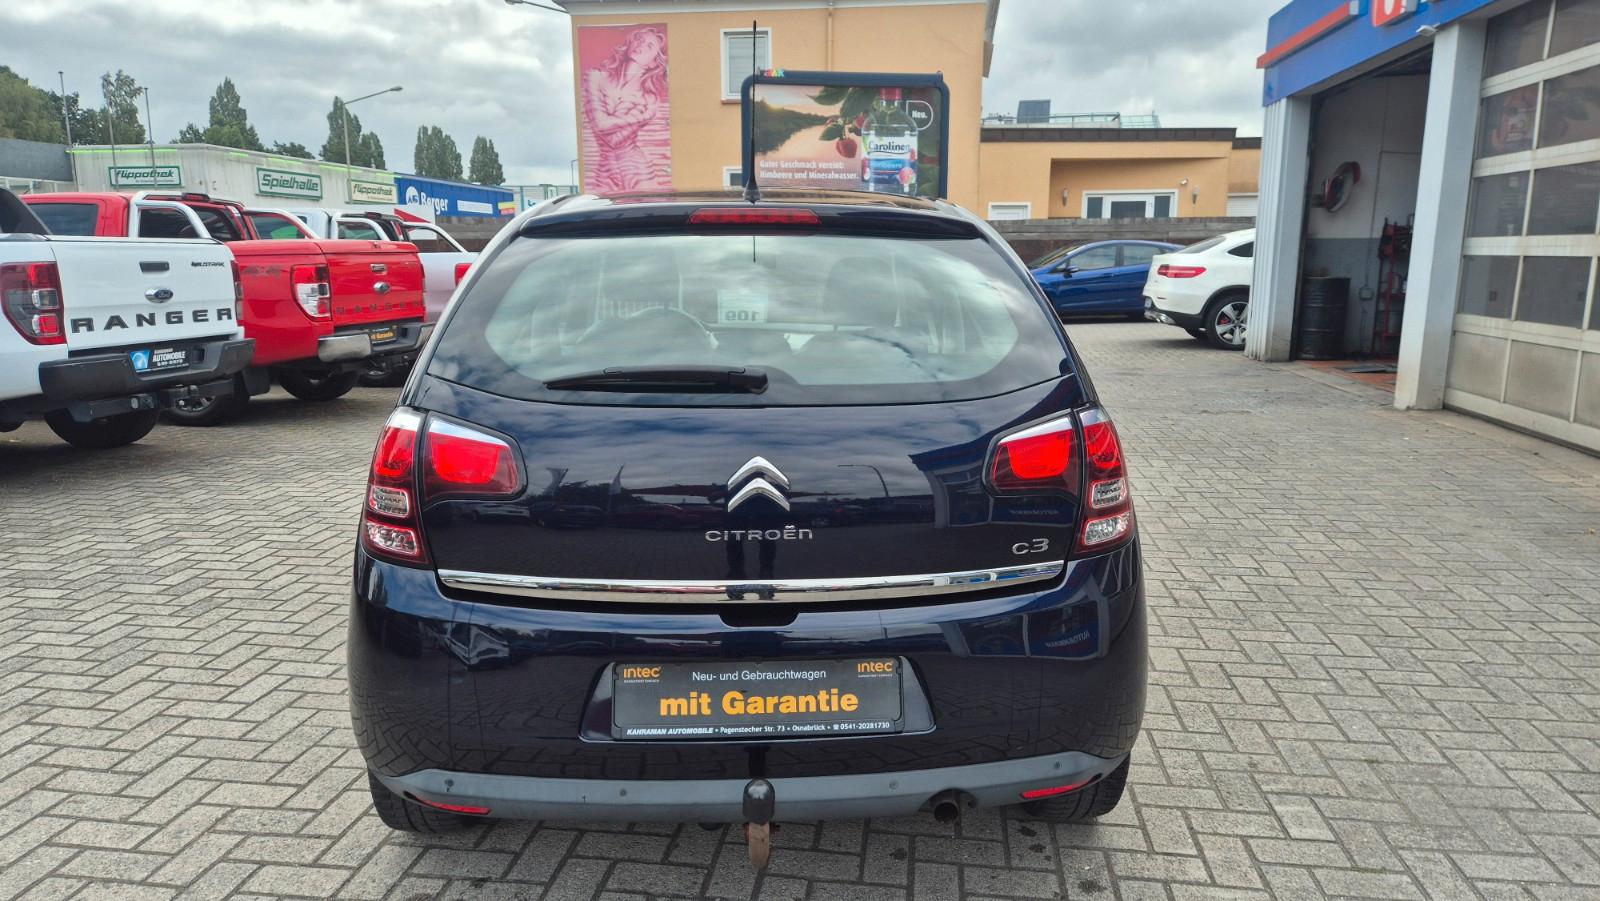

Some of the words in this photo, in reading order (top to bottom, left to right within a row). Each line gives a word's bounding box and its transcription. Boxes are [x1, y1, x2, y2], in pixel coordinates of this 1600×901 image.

[911, 110, 928, 119] Neu.
[780, 160, 817, 169] Geschmack
[793, 171, 808, 179] und
[809, 171, 860, 180] Mineralwasser.
[261, 174, 319, 192] Spielhalle
[420, 192, 449, 215] Berger
[70, 308, 233, 333] RANGER
[153, 351, 186, 362] AUTOMOBILE
[692, 671, 716, 681] Neu-
[719, 671, 738, 680] und
[741, 670, 827, 681] Gebrauchtwagen
[660, 691, 711, 716] mit
[722, 688, 859, 715] Garantie
[720, 726, 762, 734] Pagenstecher
[792, 723, 826, 731] Osnabrück
